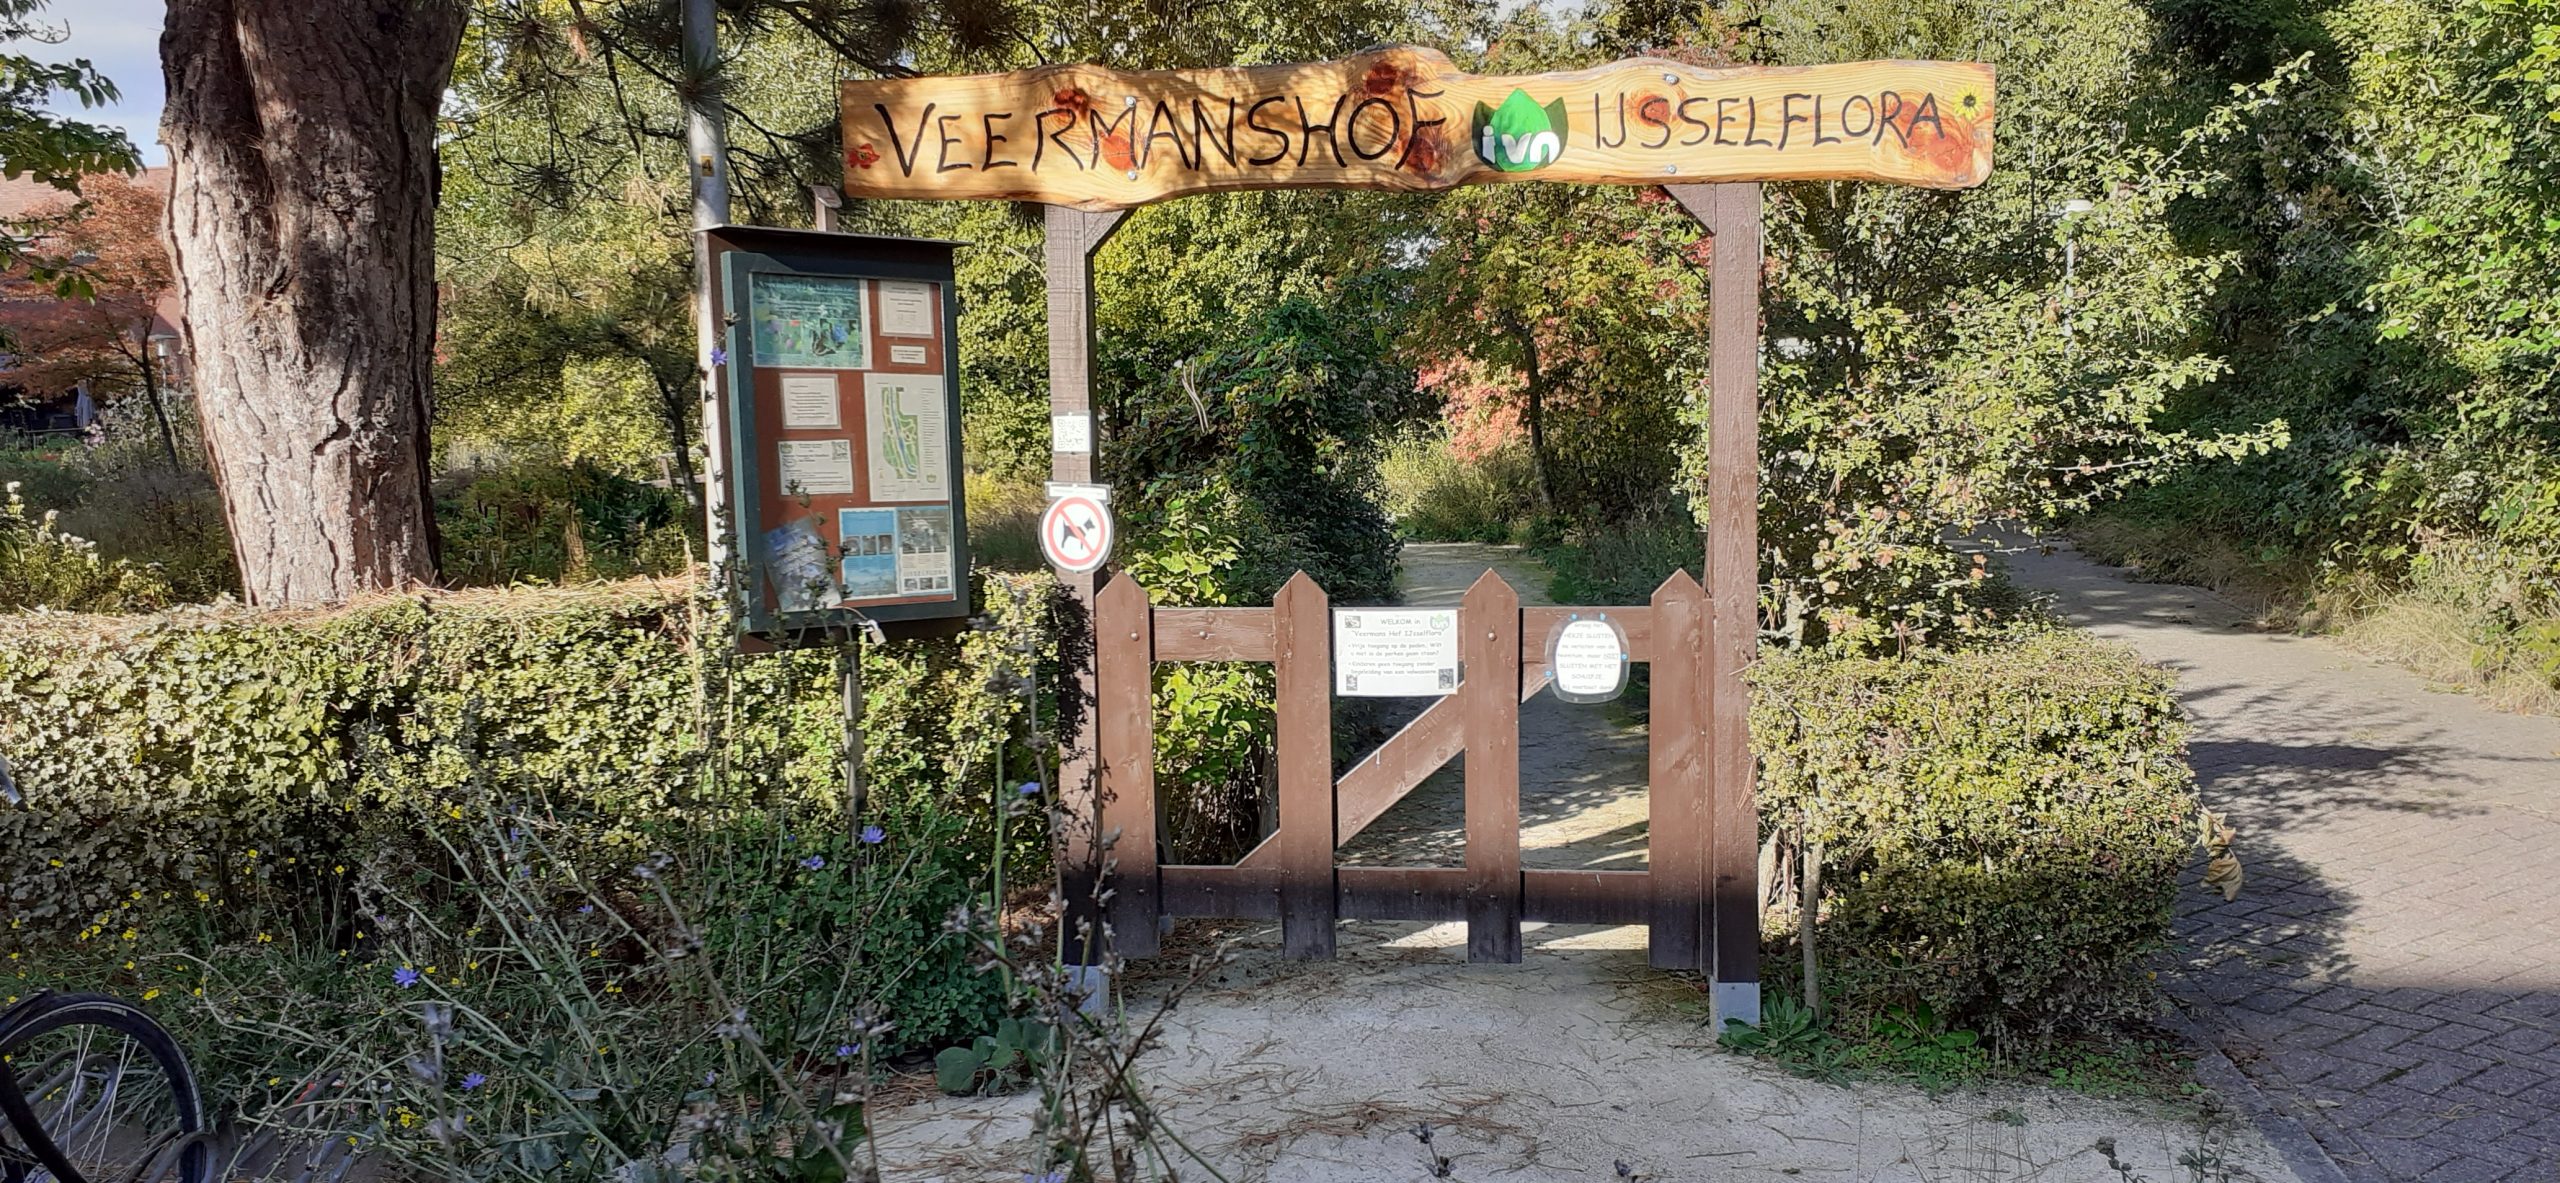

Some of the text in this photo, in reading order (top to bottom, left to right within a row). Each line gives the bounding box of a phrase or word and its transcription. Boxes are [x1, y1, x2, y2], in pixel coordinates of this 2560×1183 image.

[875, 88, 1945, 178] VEERMANSHOF IJSSELFLORA
[1482, 125, 1561, 165] ivn
[702, 159, 713, 172] 4
[1414, 617, 1421, 625] in
